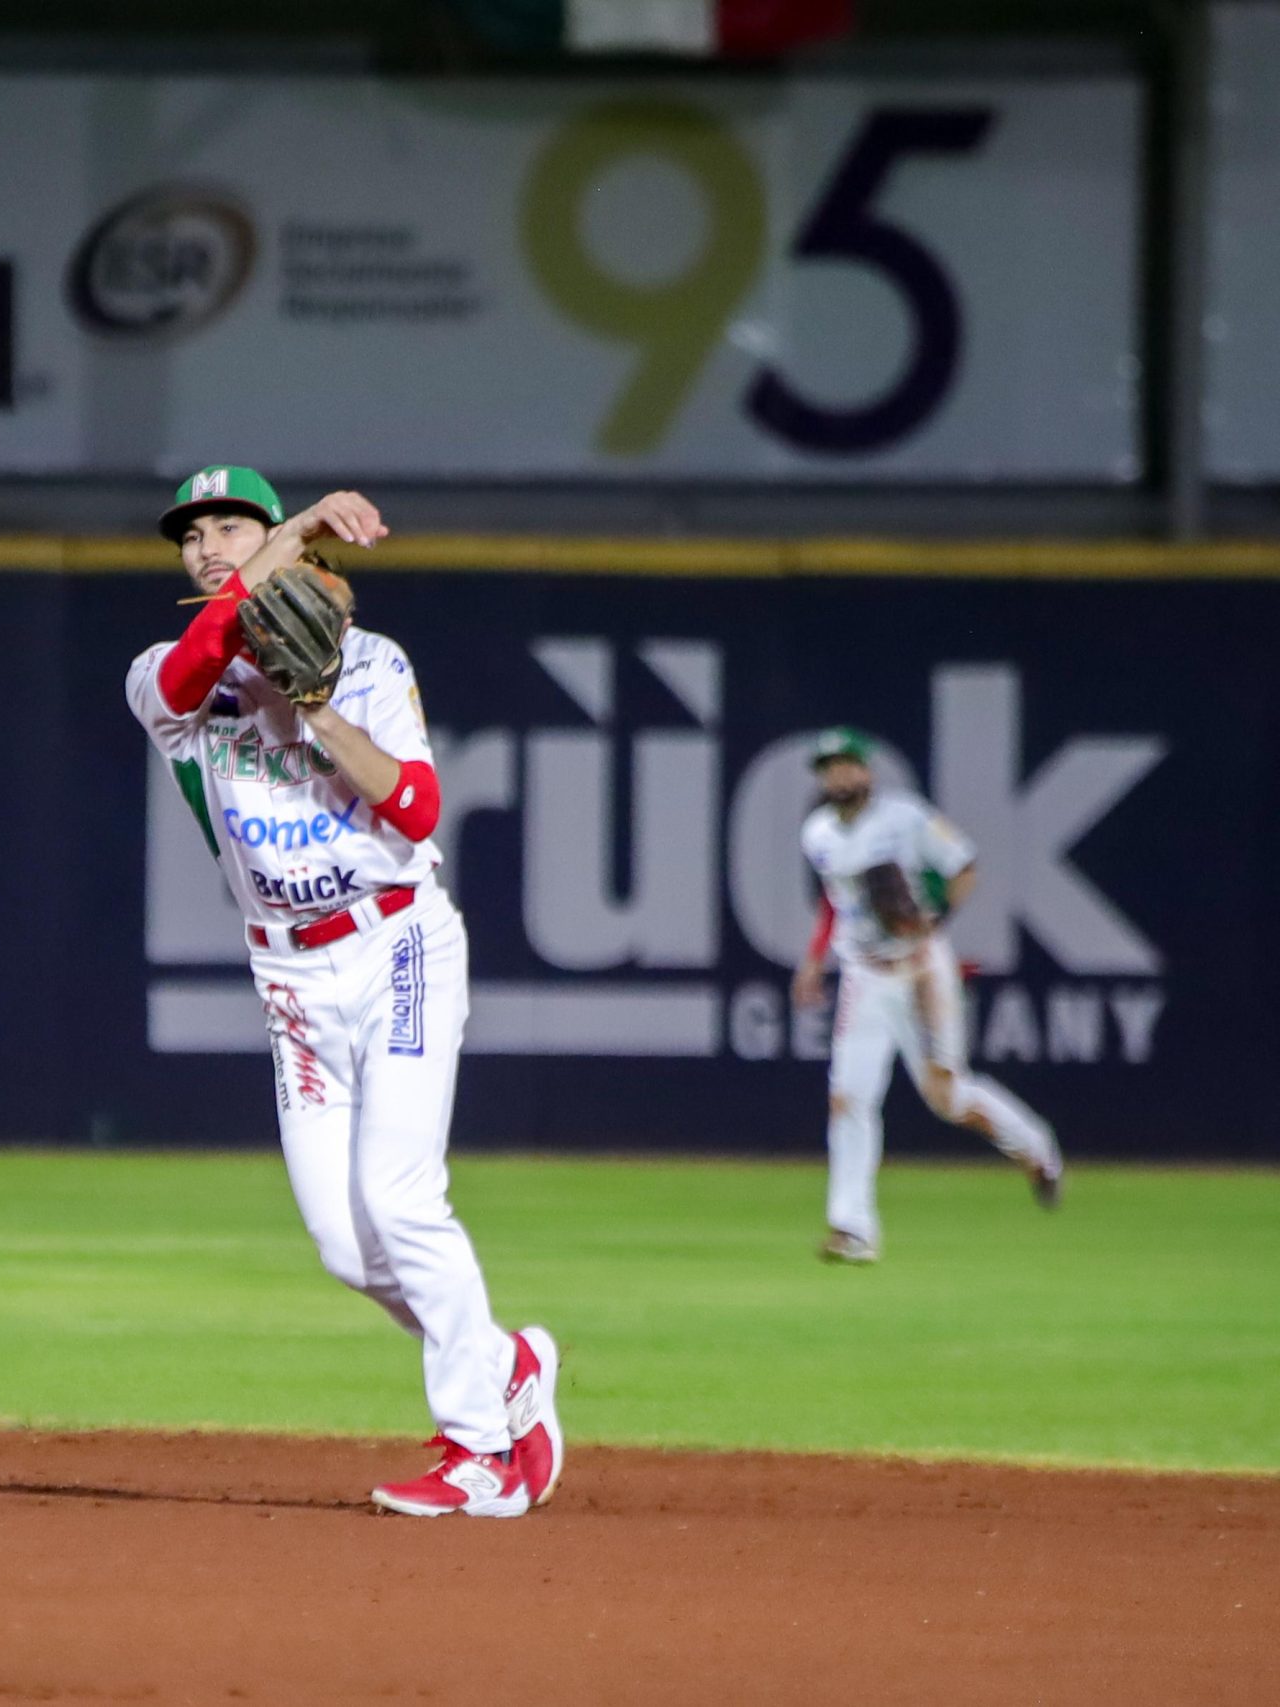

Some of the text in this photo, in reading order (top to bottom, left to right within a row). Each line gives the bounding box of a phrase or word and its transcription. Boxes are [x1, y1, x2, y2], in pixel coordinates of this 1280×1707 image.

[524, 95, 1000, 458] 95
[191, 469, 229, 501] M
[206, 724, 339, 790] MÉXIC
[249, 865, 364, 905] Brück
[728, 983, 1166, 1065] GEANY
